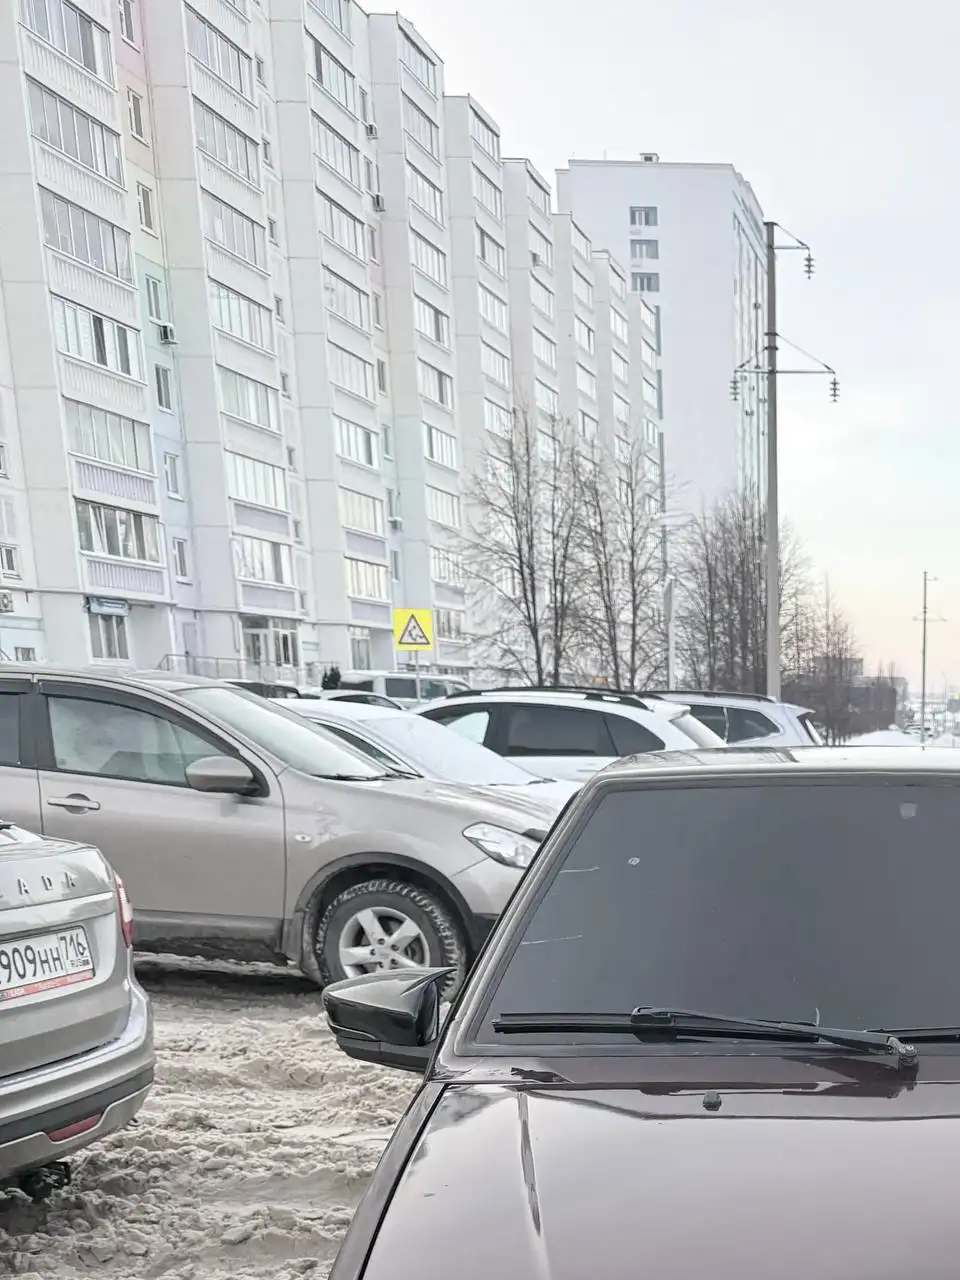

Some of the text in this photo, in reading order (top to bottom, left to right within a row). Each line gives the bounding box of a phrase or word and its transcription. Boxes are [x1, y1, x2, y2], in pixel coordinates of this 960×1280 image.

[0, 871, 76, 898] ADA
[0, 933, 87, 984] 909НН 716
